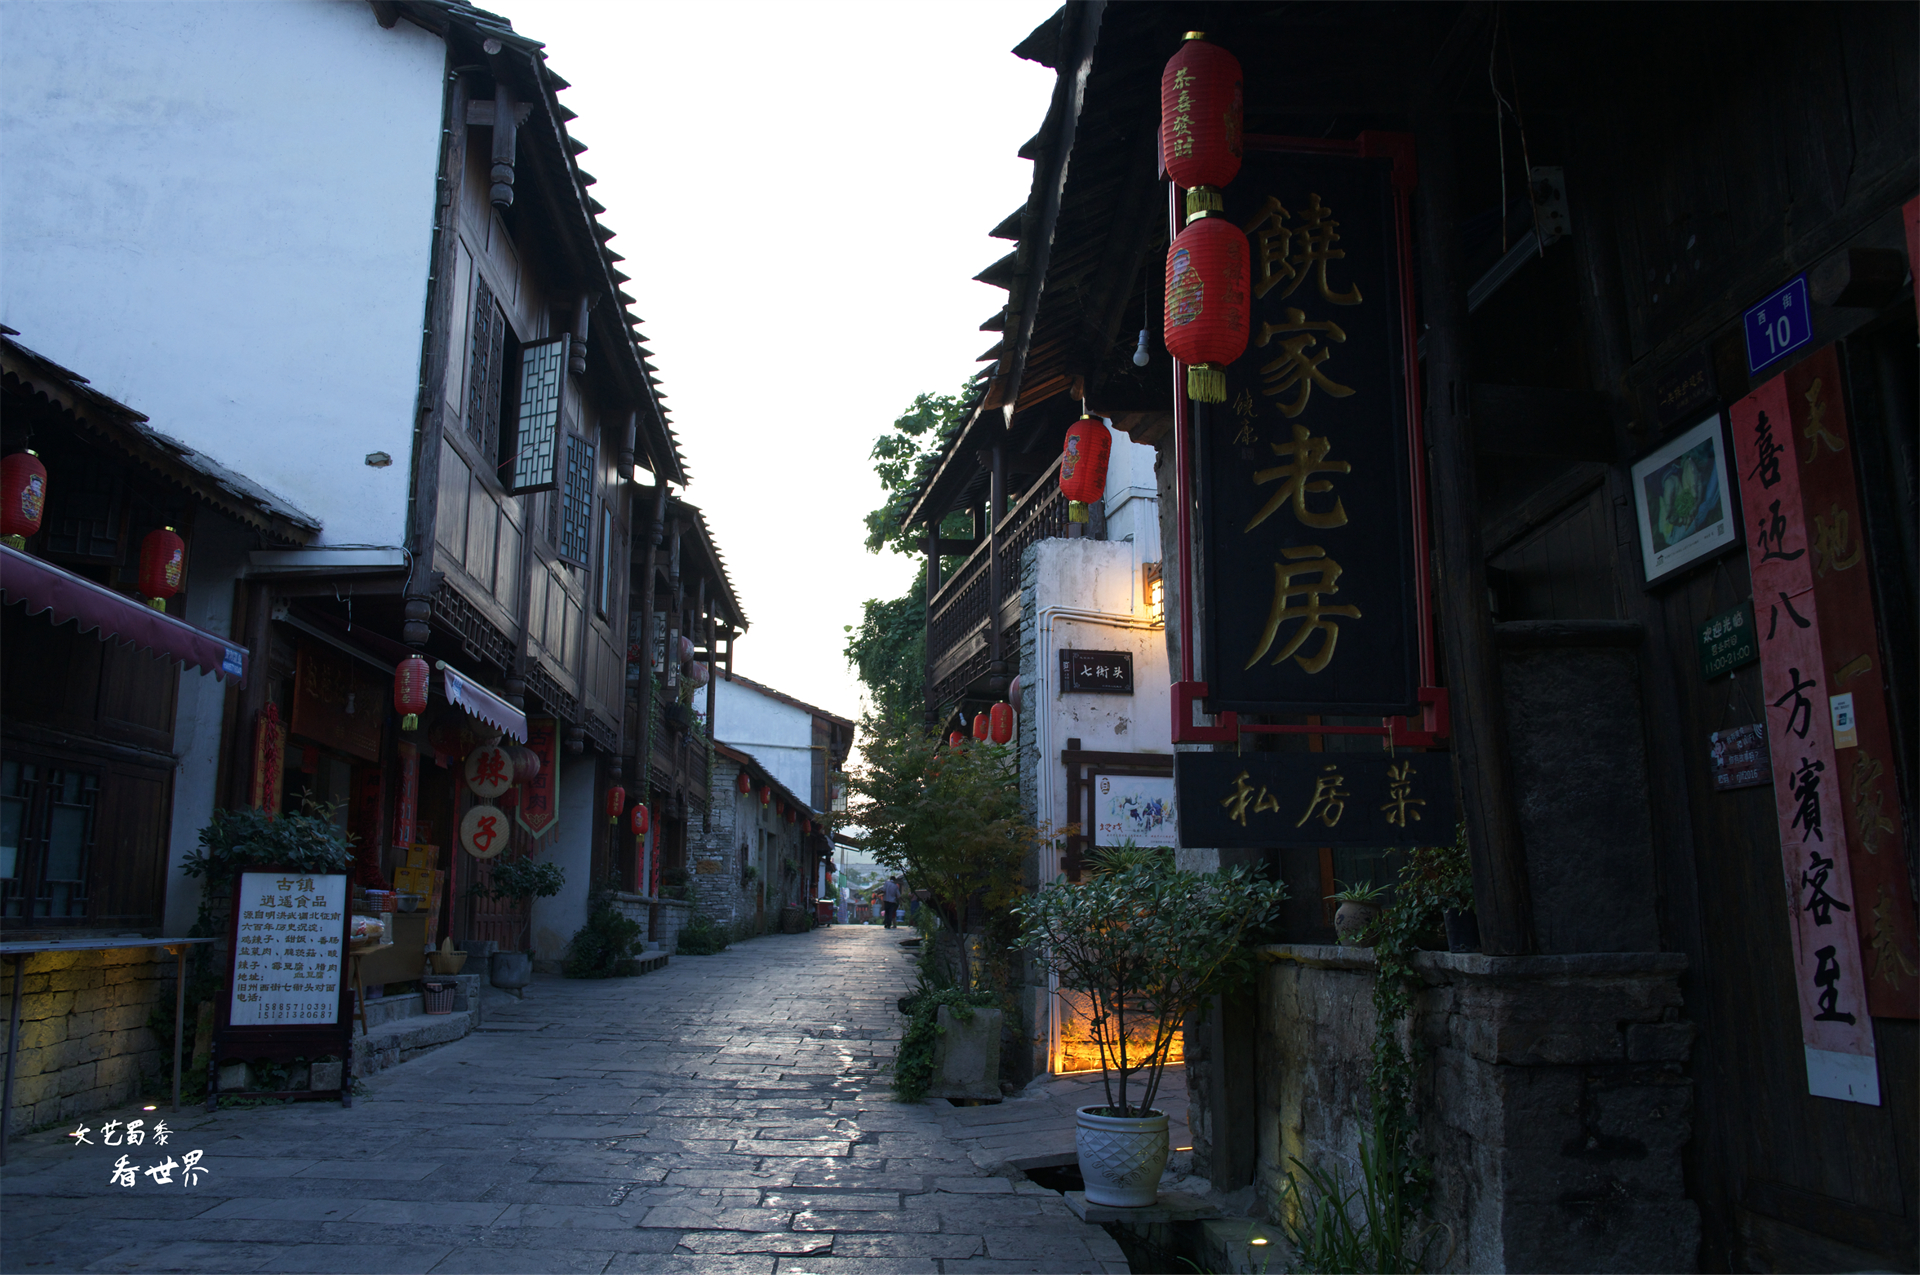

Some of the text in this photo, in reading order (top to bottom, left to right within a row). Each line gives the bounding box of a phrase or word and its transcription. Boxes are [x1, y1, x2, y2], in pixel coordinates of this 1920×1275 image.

[1172, 66, 1196, 160] 恭喜發財
[1757, 292, 1793, 327] 西街
[1765, 315, 1791, 354] 10
[1702, 610, 1744, 645] 欢迎光临
[1705, 645, 1750, 675] 11:00-21:00
[1711, 634, 1738, 657] 营业时间
[1220, 760, 1426, 829] 私房菜
[276, 877, 316, 892] 古镇
[259, 894, 327, 909] 逍遥食品
[257, 1011, 332, 1020] 15121320687
[258, 1003, 332, 1011] 15885710391
